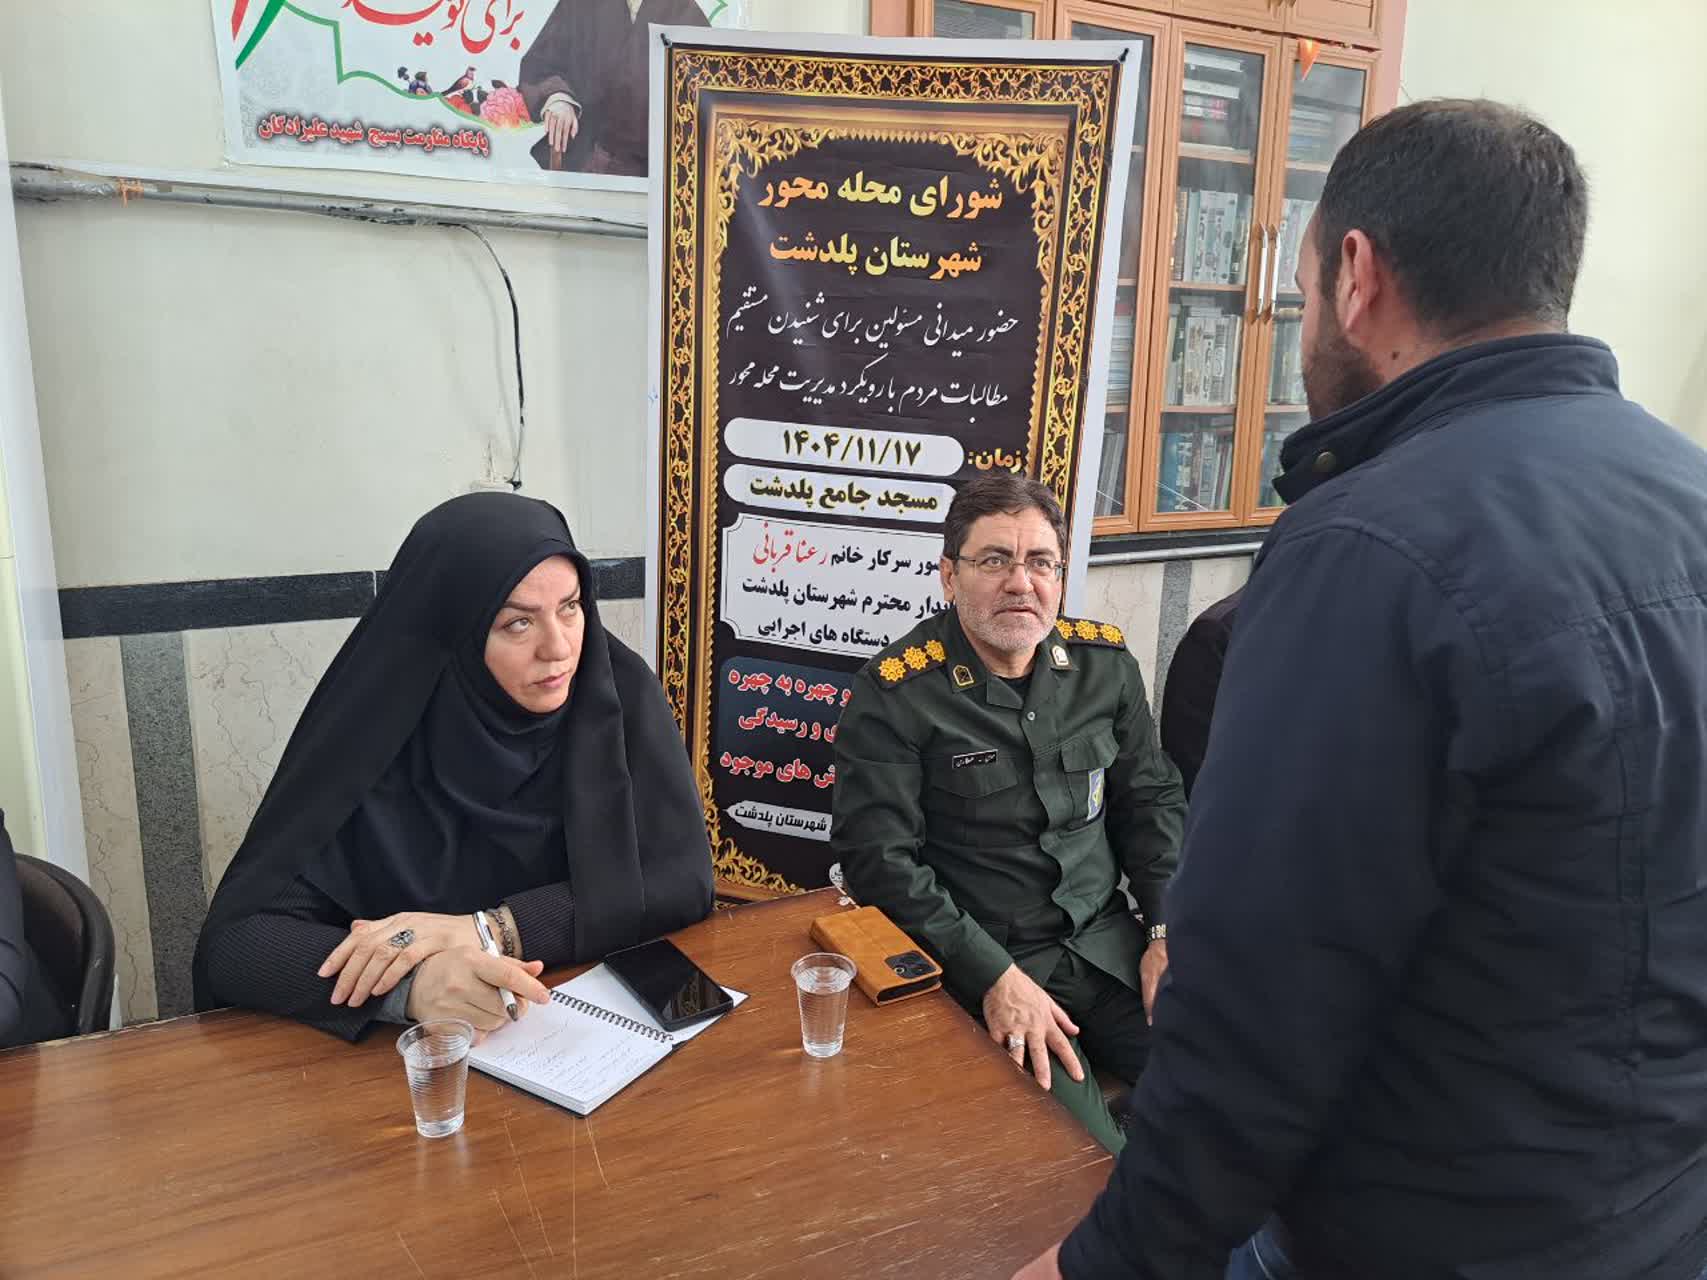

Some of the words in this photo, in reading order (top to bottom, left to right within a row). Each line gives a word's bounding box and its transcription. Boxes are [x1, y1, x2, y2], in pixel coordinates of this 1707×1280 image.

[329, 121, 363, 142] شهید
[367, 126, 401, 147] بسیج
[403, 126, 450, 150] مقاومت
[451, 128, 489, 156] پایگاه
[758, 175, 829, 208] محور
[837, 170, 902, 204] محله
[910, 175, 1003, 219] شورای
[769, 231, 858, 276] پلدشت
[865, 236, 982, 280] شهرستان
[726, 285, 769, 340] مستقیم
[768, 291, 826, 345] شنیدن
[821, 306, 864, 344] برای
[977, 308, 1019, 344] حضور
[864, 305, 923, 350] مسئولین
[923, 302, 973, 358] میدانی
[728, 361, 757, 386] محور
[752, 364, 780, 389] محله
[779, 370, 836, 406] مدیریت
[838, 352, 889, 404] رویکرد
[885, 376, 896, 413] با
[898, 382, 938, 415] مردم
[940, 382, 1008, 424] مطالبات
[782, 428, 922, 467] ۱۴۰۴/۱۱/۱۷
[968, 448, 1022, 474] زمان:
[750, 474, 814, 508] پلدشت
[818, 481, 872, 511] جامع
[877, 486, 939, 513] مسجد
[831, 545, 864, 567] خانم
[742, 575, 790, 606] پلدشت
[792, 582, 858, 611] شهرستان
[862, 593, 912, 616] محترم
[757, 616, 806, 638] اجرایی
[808, 622, 838, 646] های
[841, 626, 890, 648] دستگاه
[728, 669, 773, 695] چهره
[775, 674, 793, 696] به
[795, 678, 838, 705] چهره
[738, 706, 808, 738] رسیدگی
[809, 721, 822, 742] و
[719, 751, 774, 779] موجود
[775, 757, 813, 783] های
[734, 805, 774, 827] پلدشت
[775, 812, 828, 833] شهرستان
